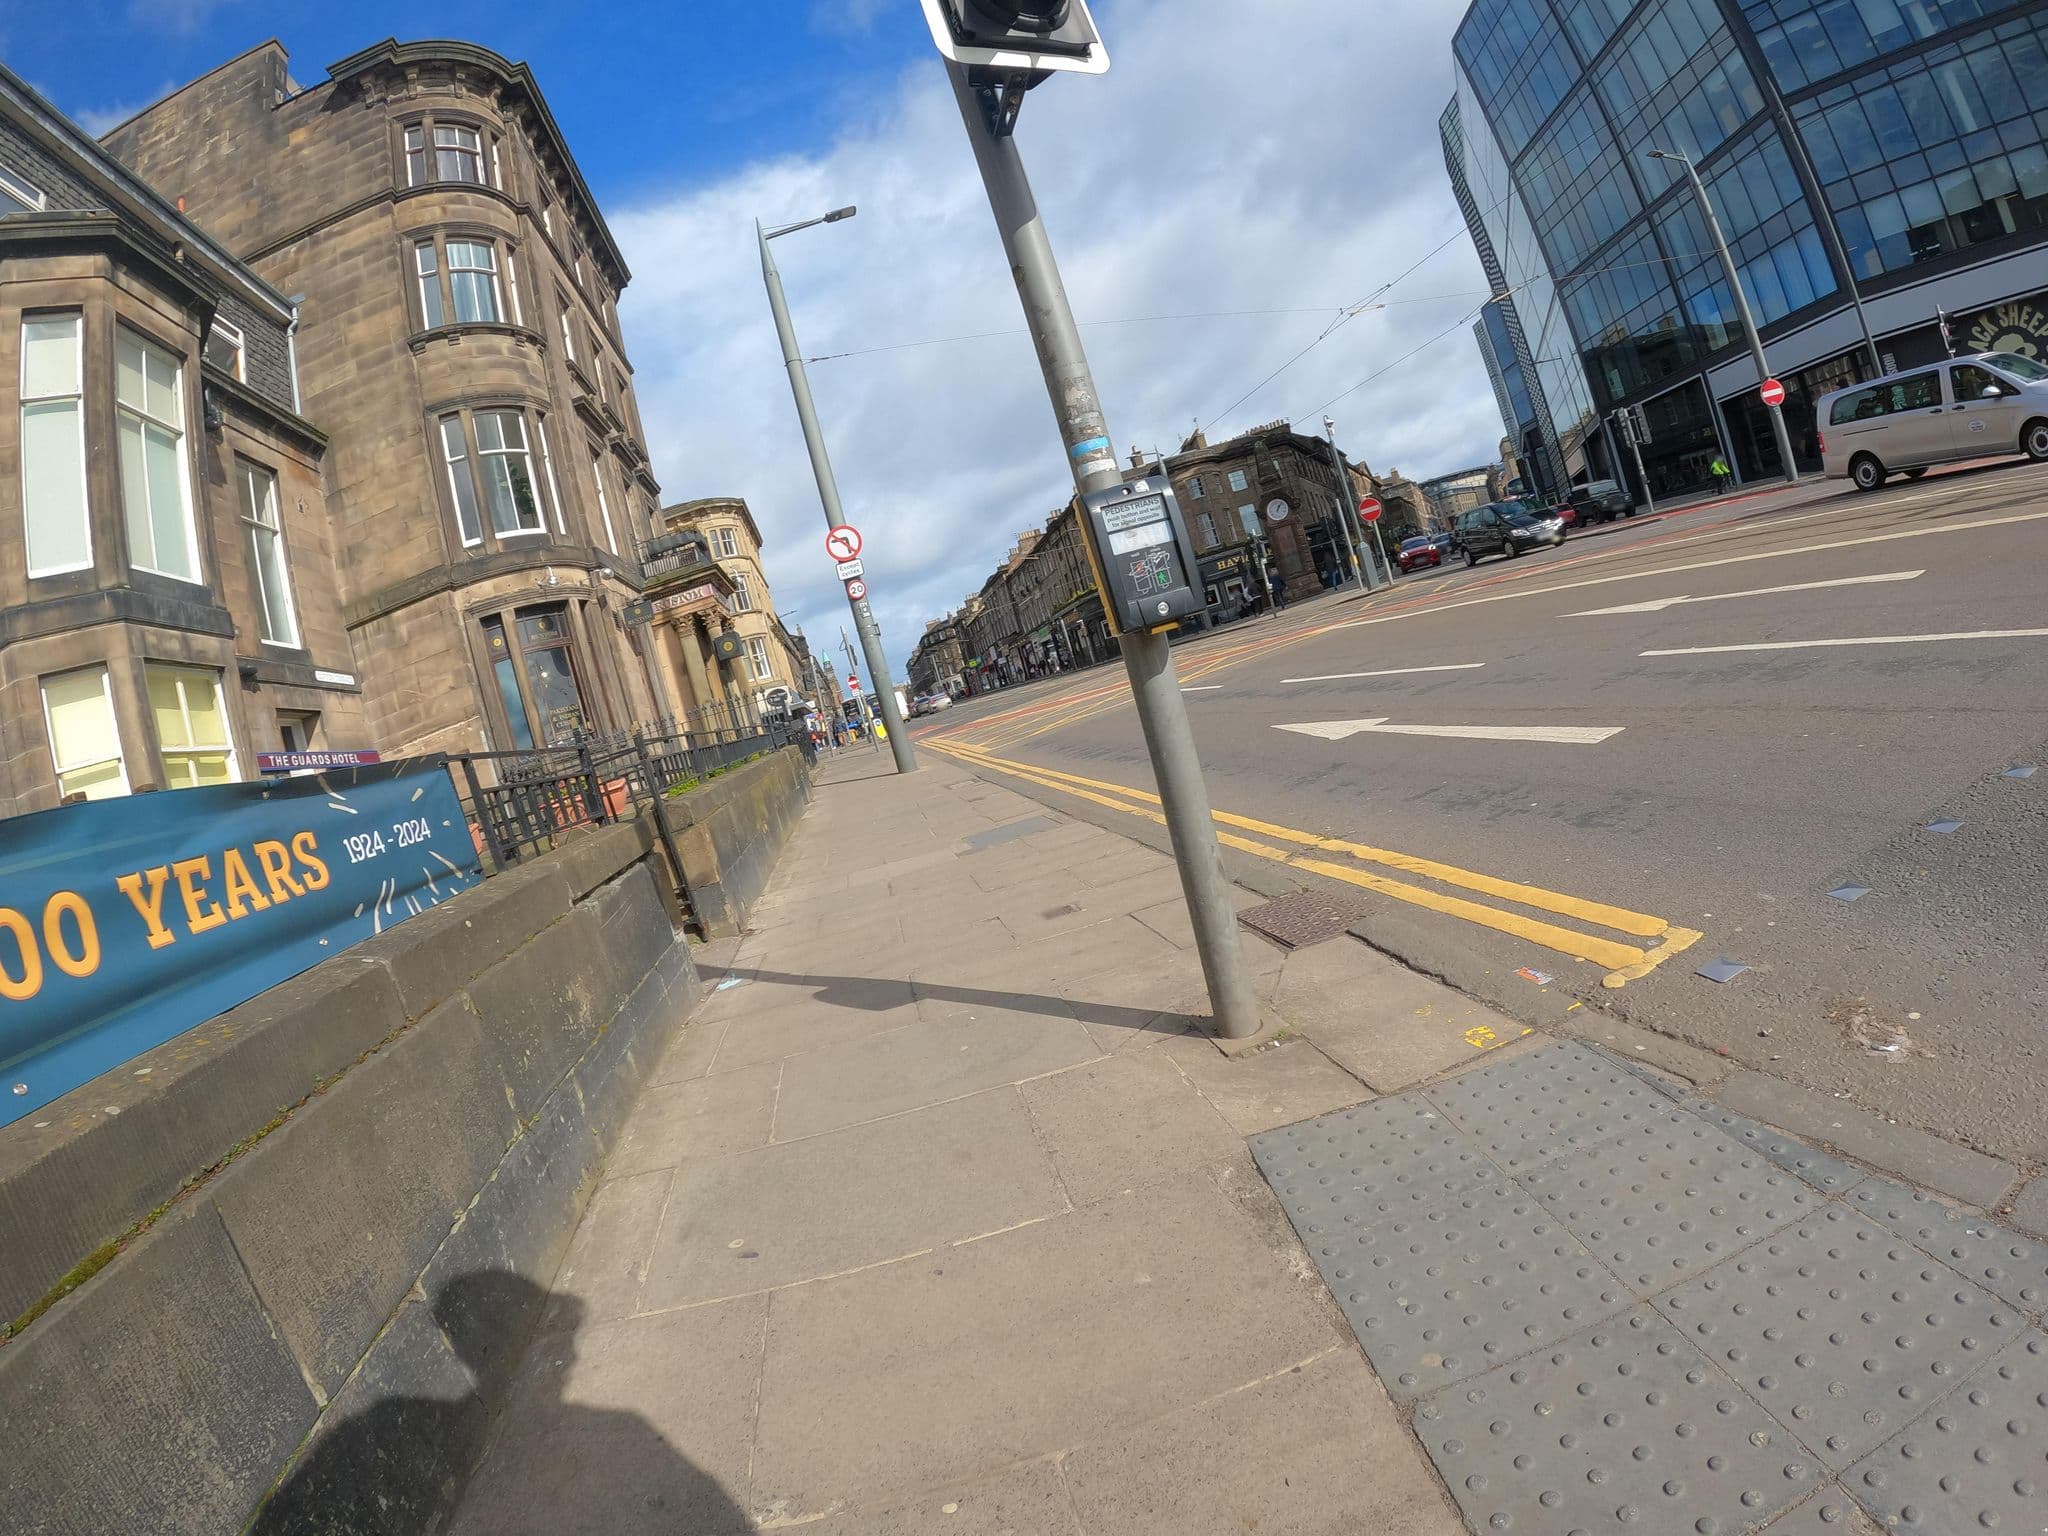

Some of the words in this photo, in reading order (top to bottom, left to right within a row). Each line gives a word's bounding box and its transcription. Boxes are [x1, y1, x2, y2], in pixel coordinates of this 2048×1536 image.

[1967, 313, 1999, 352] ACK
[1996, 303, 2048, 338] SHEEP
[1105, 498, 1160, 516] PEDESTRIANS
[850, 585, 864, 594] 20
[268, 755, 289, 767] THE
[290, 754, 331, 766] GUARDS
[332, 753, 361, 764] HOTEL
[343, 830, 385, 864] 1924
[393, 817, 431, 848] 2024
[115, 831, 331, 949] YEARS
